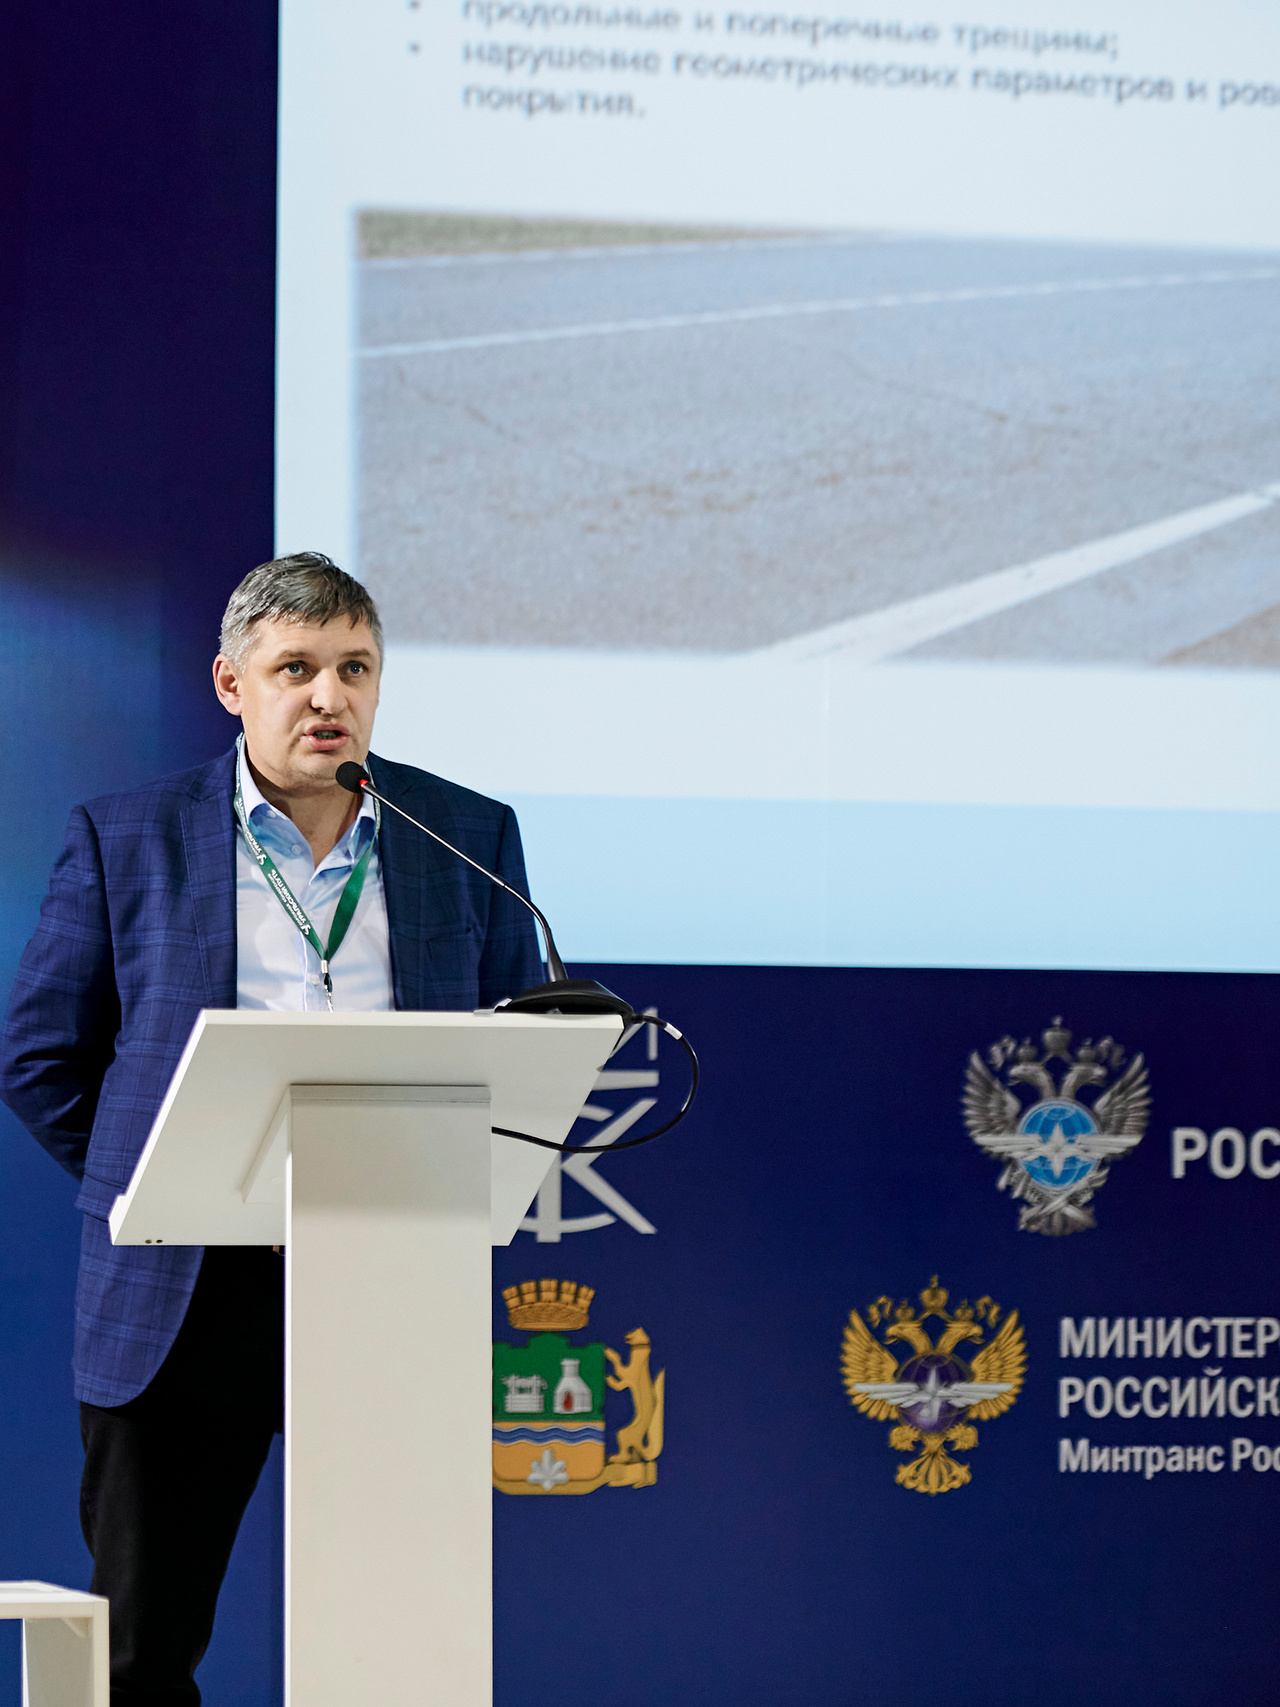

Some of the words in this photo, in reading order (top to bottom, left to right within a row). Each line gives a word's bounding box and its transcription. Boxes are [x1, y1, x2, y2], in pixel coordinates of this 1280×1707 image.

[695, 13, 715, 31] и
[463, 41, 660, 75] нарушение
[971, 65, 1175, 106] параметров
[1171, 1126, 1280, 1180] РОС
[1059, 1315, 1280, 1359] МИНИСТЕР
[1058, 1366, 1280, 1419] РОССИЙСК
[1058, 1437, 1226, 1481] Минтранс
